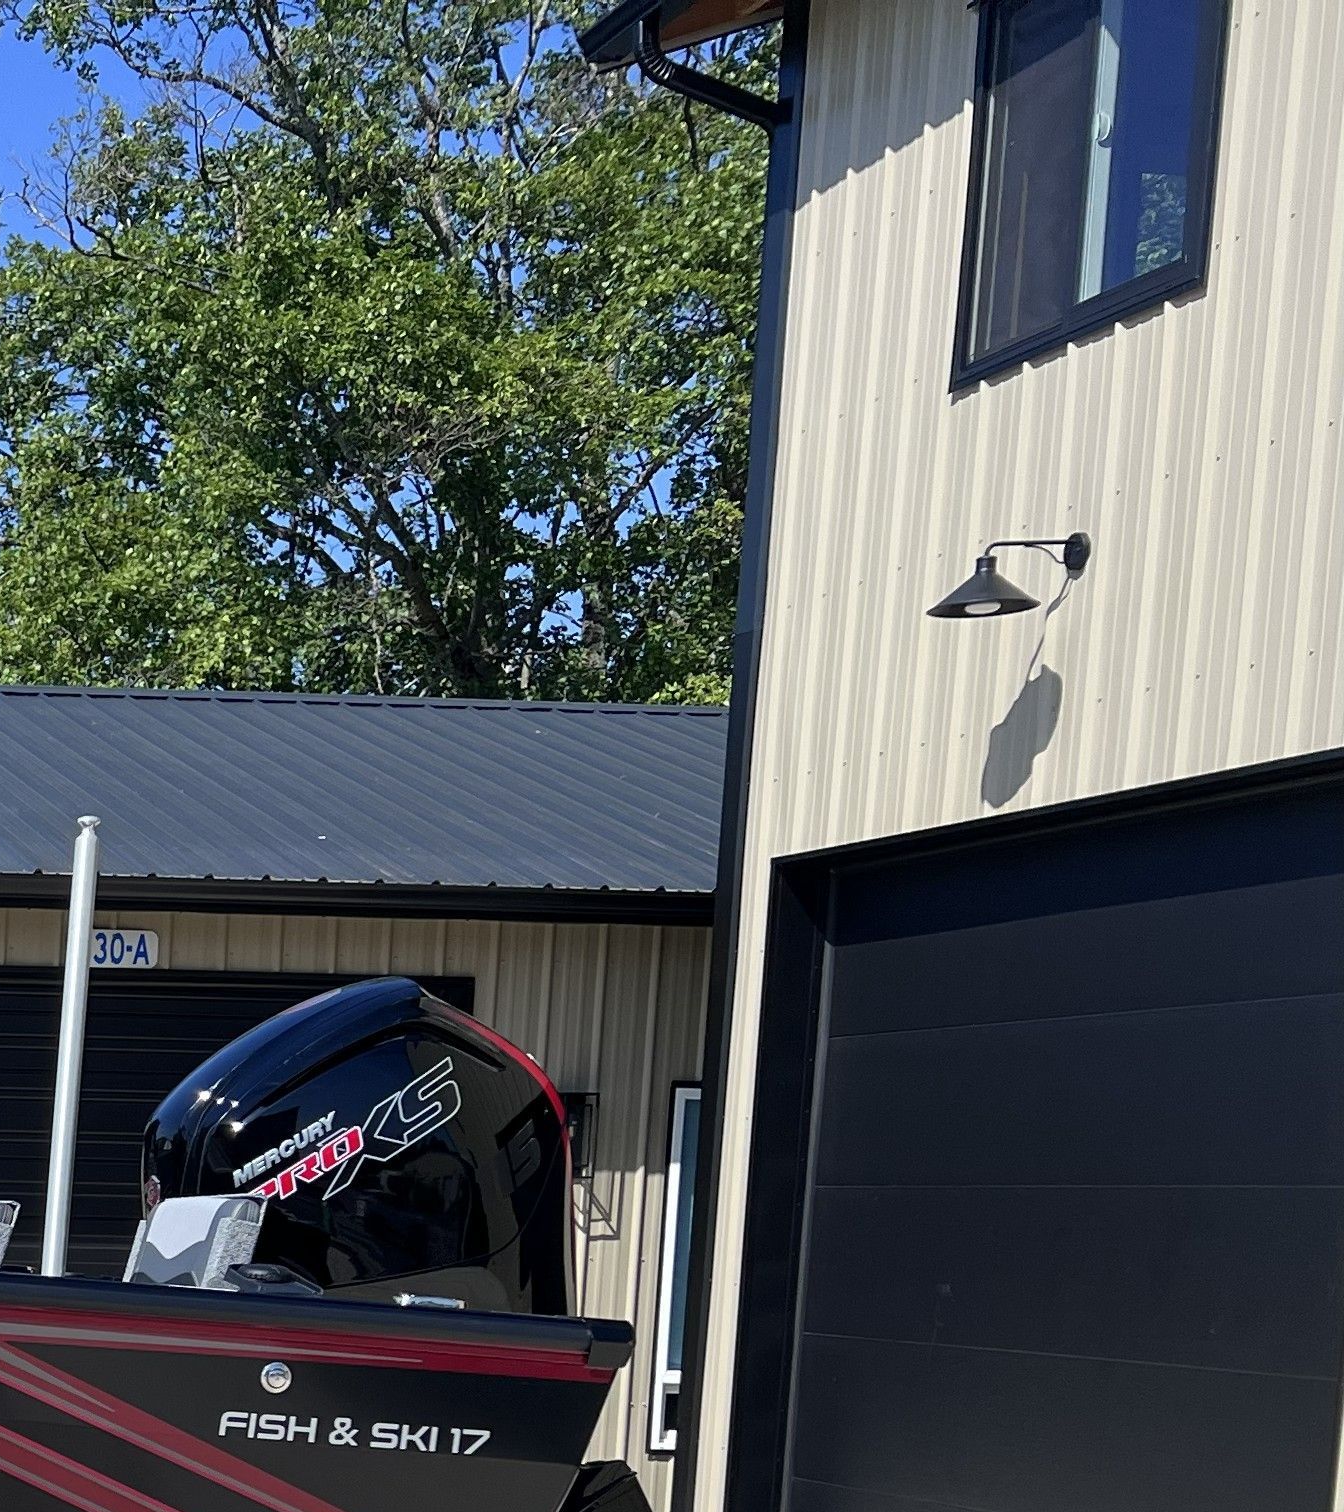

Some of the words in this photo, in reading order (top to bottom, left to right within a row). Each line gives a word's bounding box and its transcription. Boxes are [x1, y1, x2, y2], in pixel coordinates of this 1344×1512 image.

[232, 1110, 336, 1188] MERCURY
[316, 1056, 461, 1200] XS
[218, 1410, 318, 1443] FISH
[328, 1417, 359, 1447] &
[369, 1422, 439, 1452] SKI
[450, 1427, 491, 1454] 17
